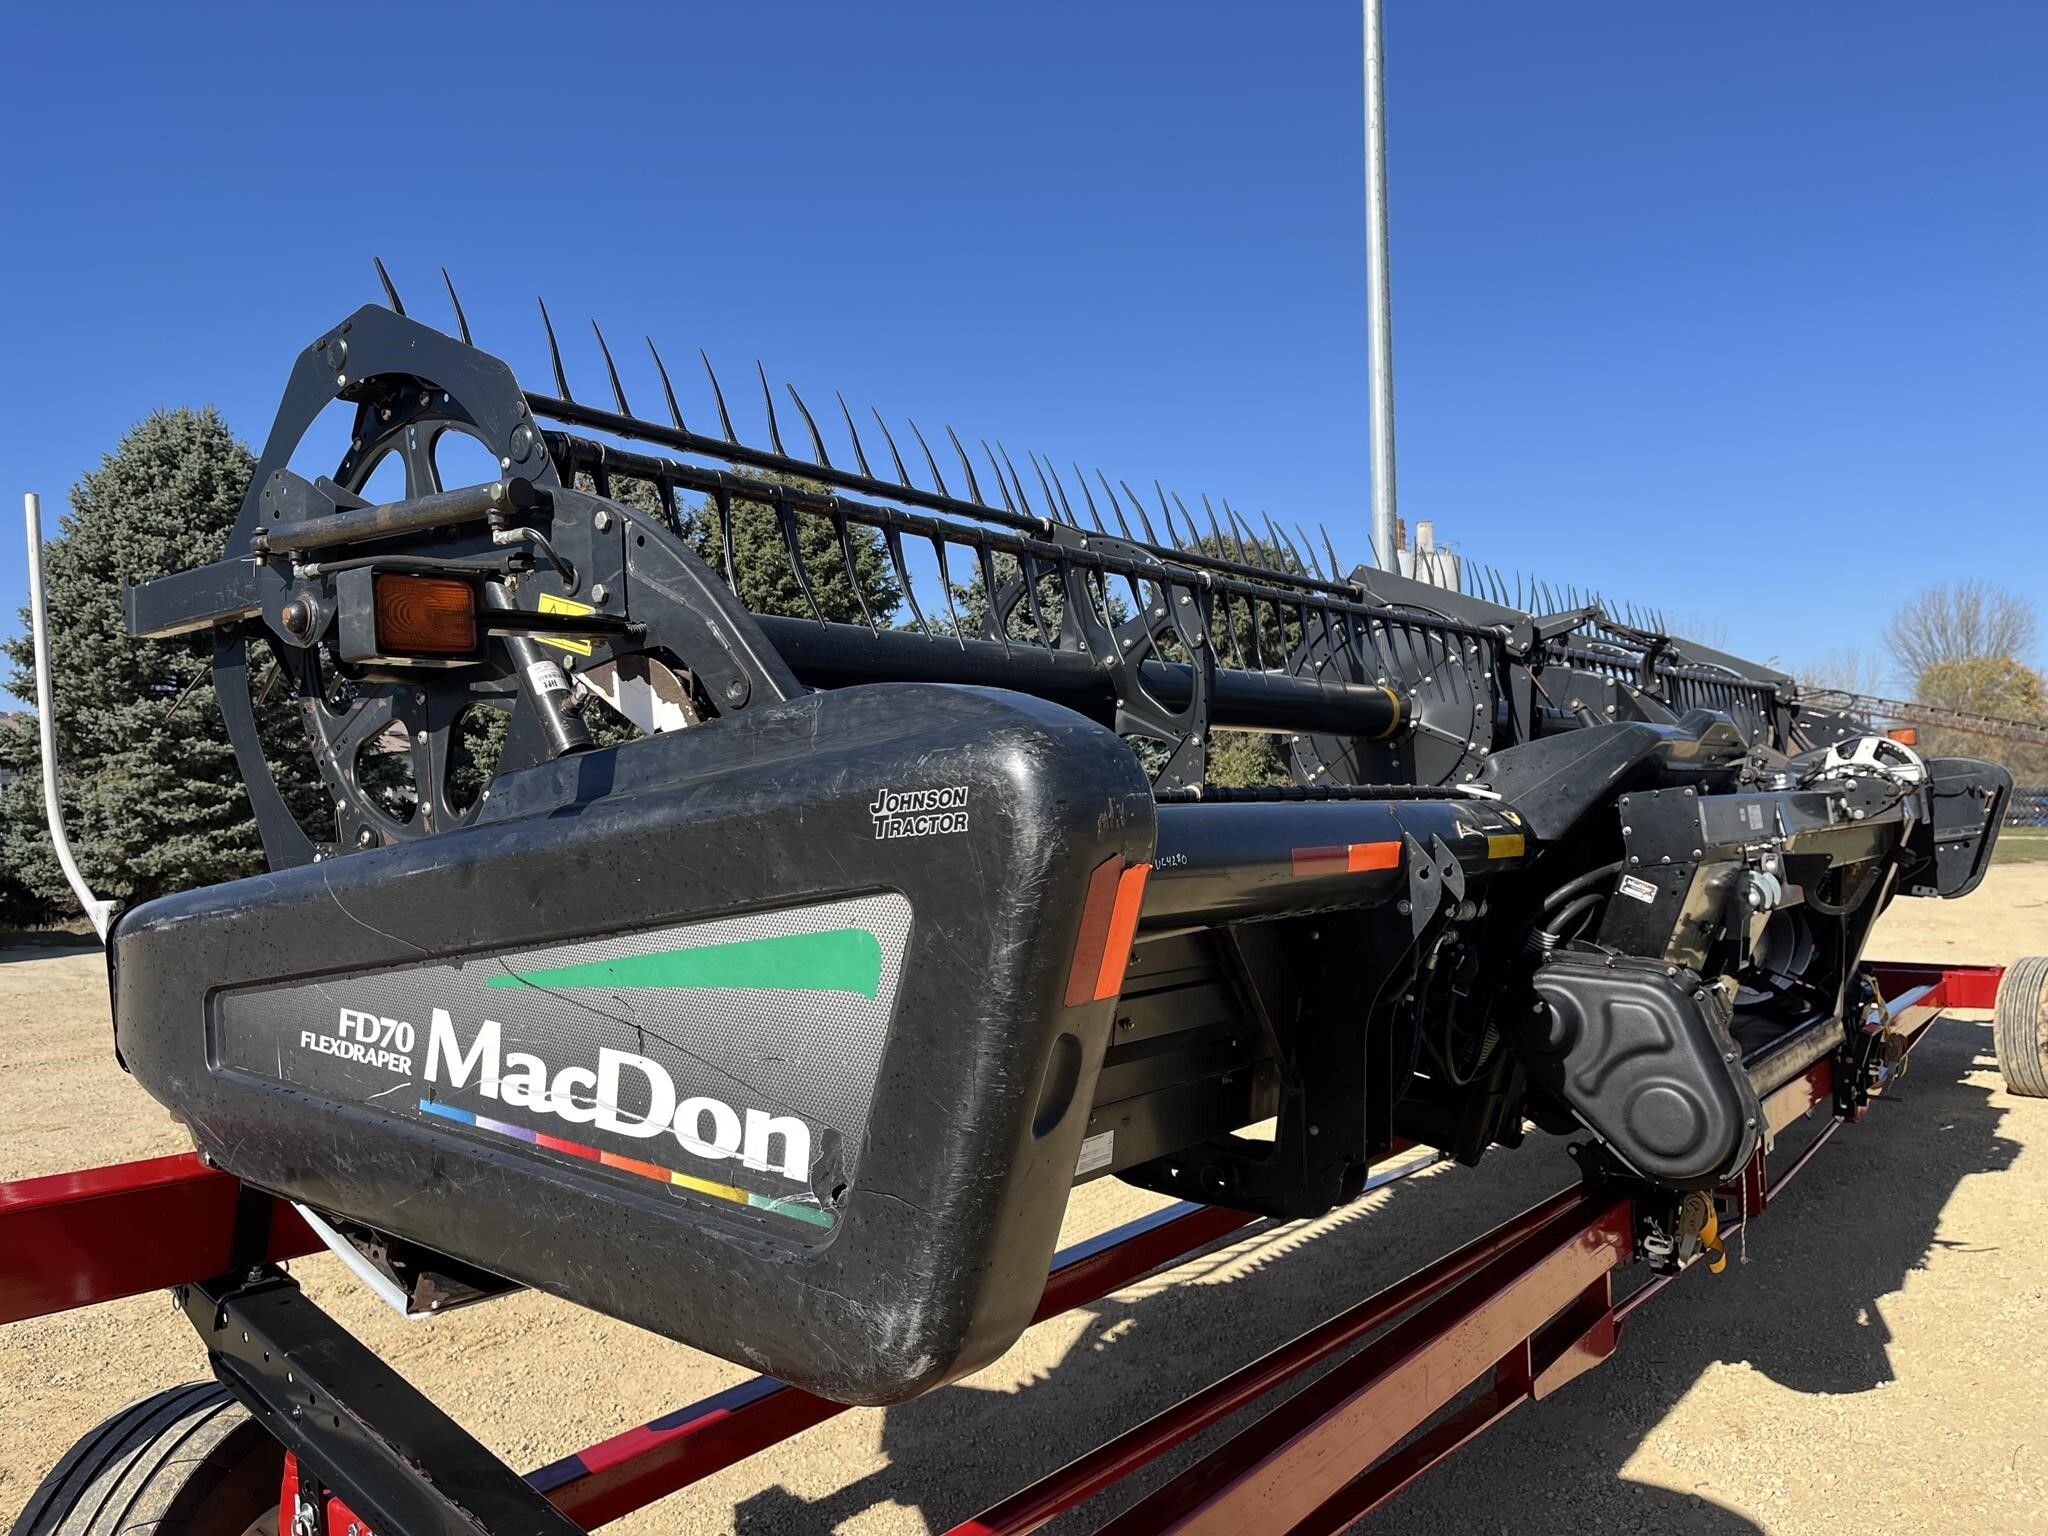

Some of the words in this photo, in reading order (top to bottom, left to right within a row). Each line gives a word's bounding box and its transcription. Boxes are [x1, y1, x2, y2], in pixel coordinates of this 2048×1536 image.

[869, 786, 969, 816] JOHNSON
[872, 812, 969, 839] TRACTOR
[300, 1030, 412, 1076] FLEXDRAPER
[338, 1007, 415, 1053] FD70
[423, 1007, 811, 1184] MacDon
